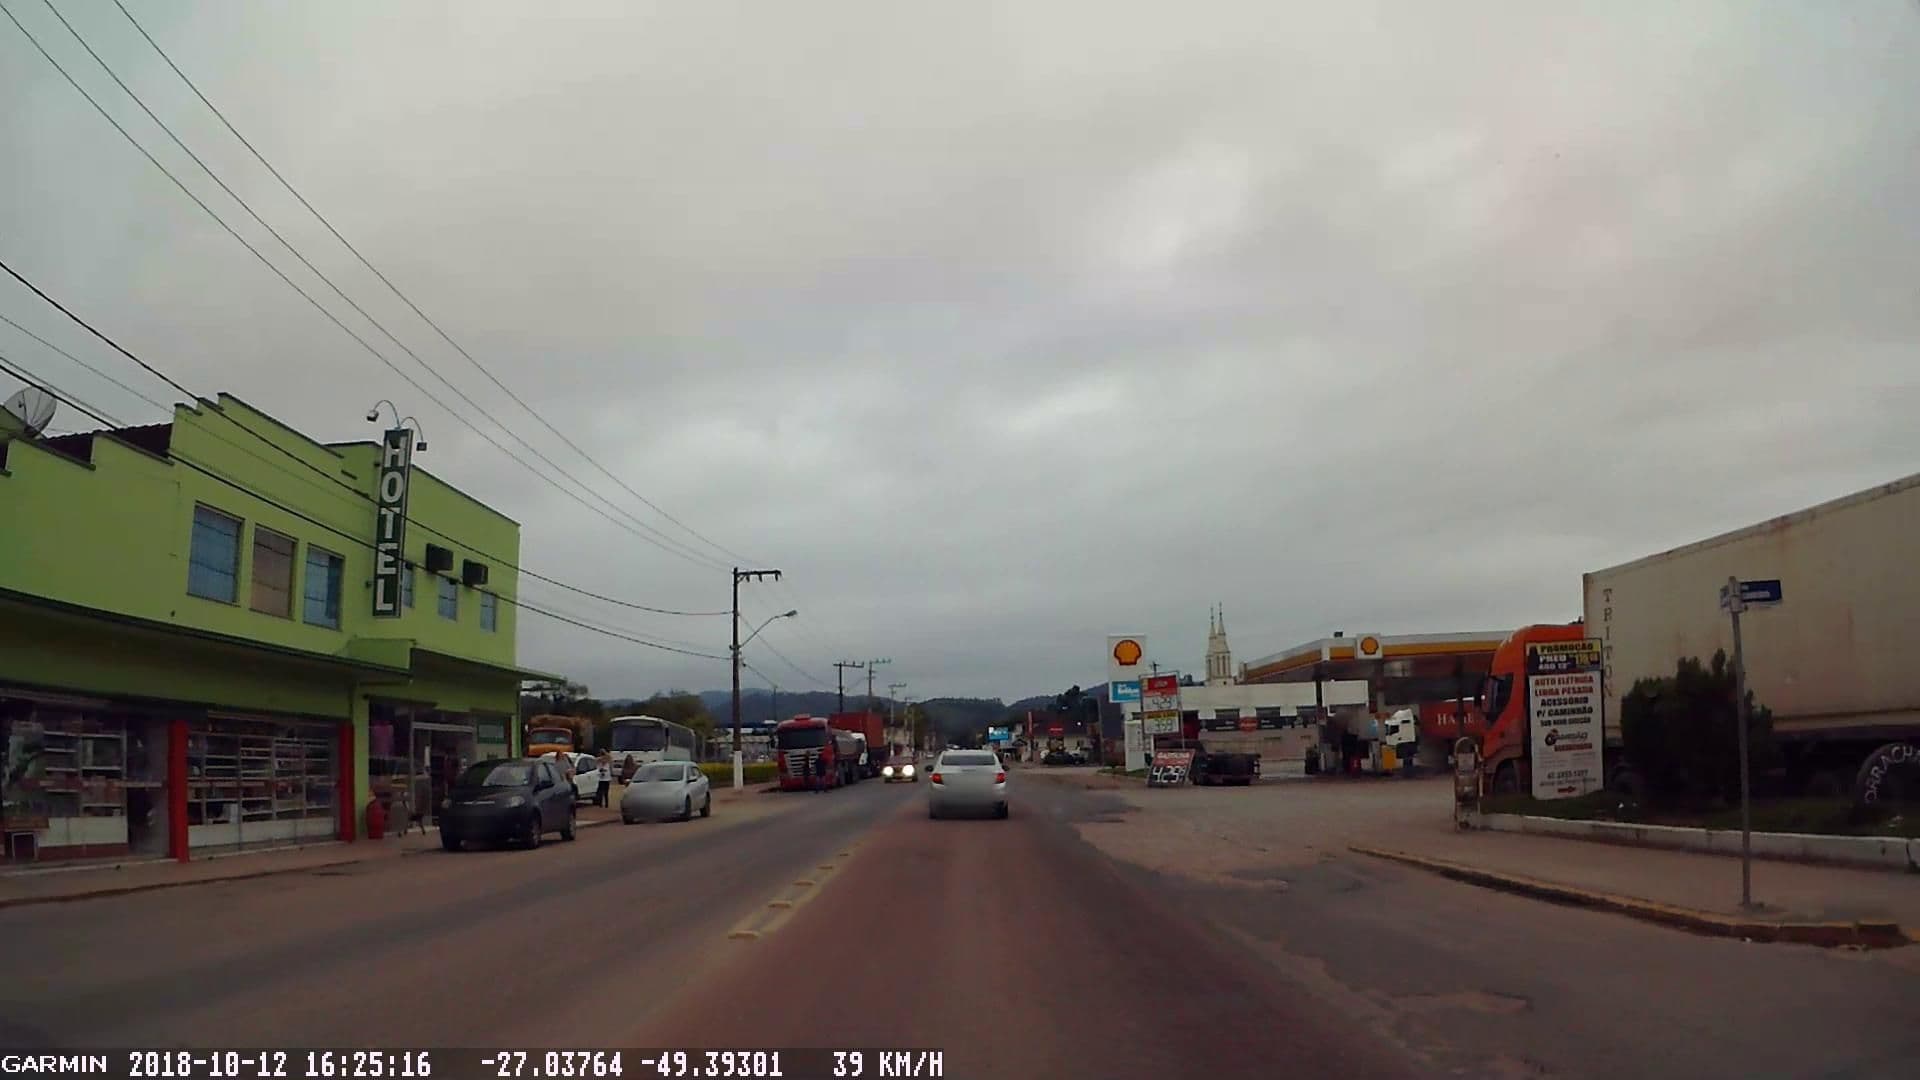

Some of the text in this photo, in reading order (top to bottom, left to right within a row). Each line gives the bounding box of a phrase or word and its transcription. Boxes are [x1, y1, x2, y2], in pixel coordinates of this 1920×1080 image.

[376, 434, 409, 612] HOTEL
[1534, 677, 1556, 686] AUTO
[1602, 587, 1614, 698] TRITON
